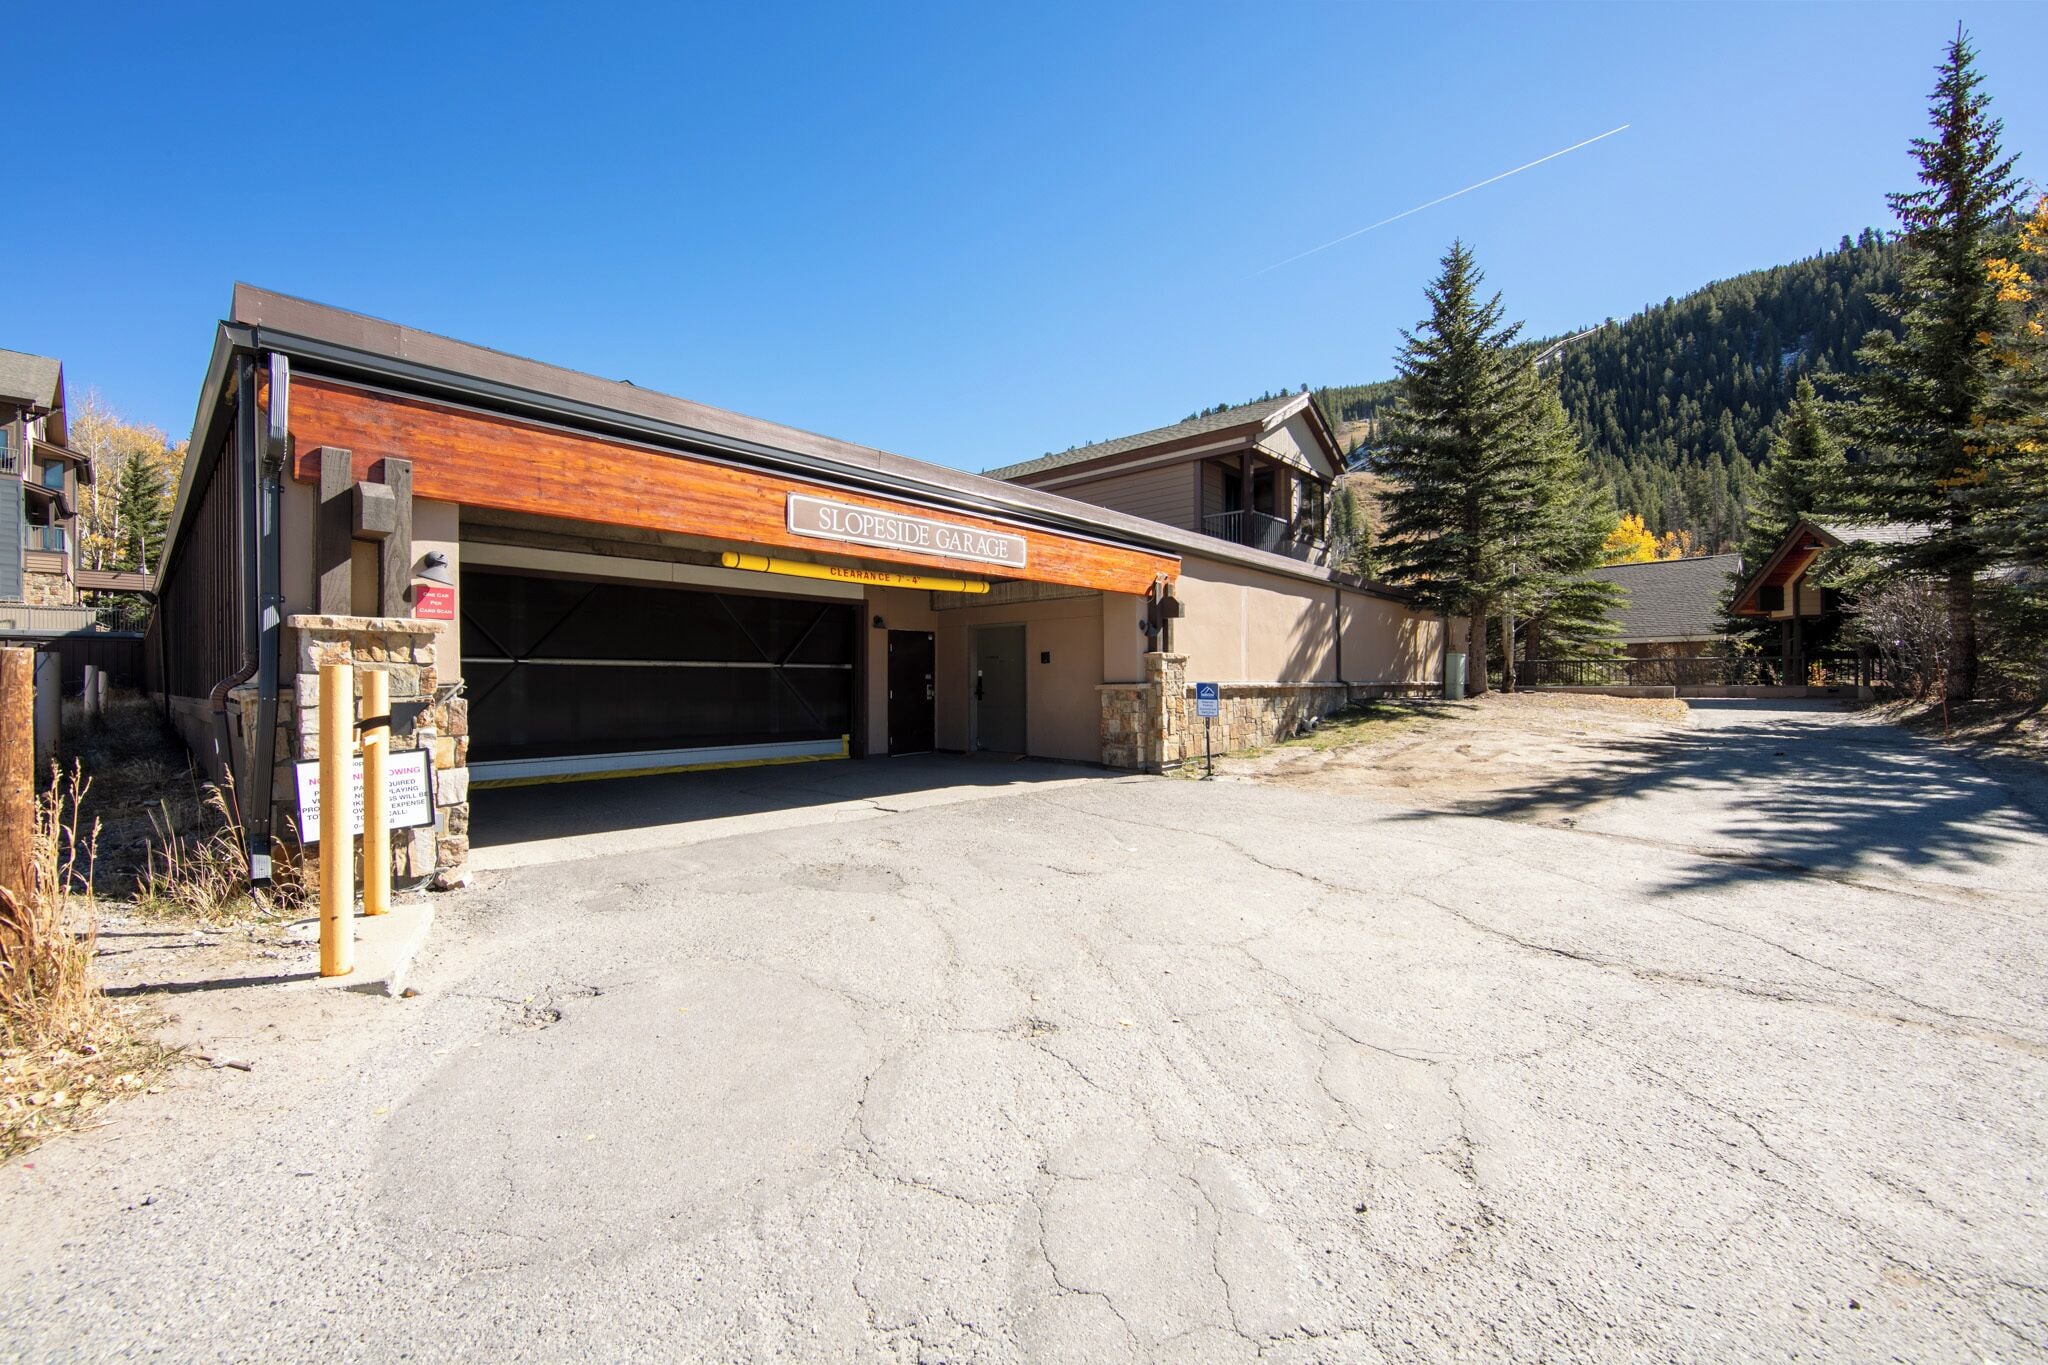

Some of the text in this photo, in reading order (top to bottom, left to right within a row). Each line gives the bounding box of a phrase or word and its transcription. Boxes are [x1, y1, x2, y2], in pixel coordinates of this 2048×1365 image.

[818, 506, 1009, 559] SLOPESIDE GARAGE
[830, 567, 890, 582] CLEARANCE
[389, 766, 421, 776] OWING
[391, 799, 425, 809] EXPENSE
